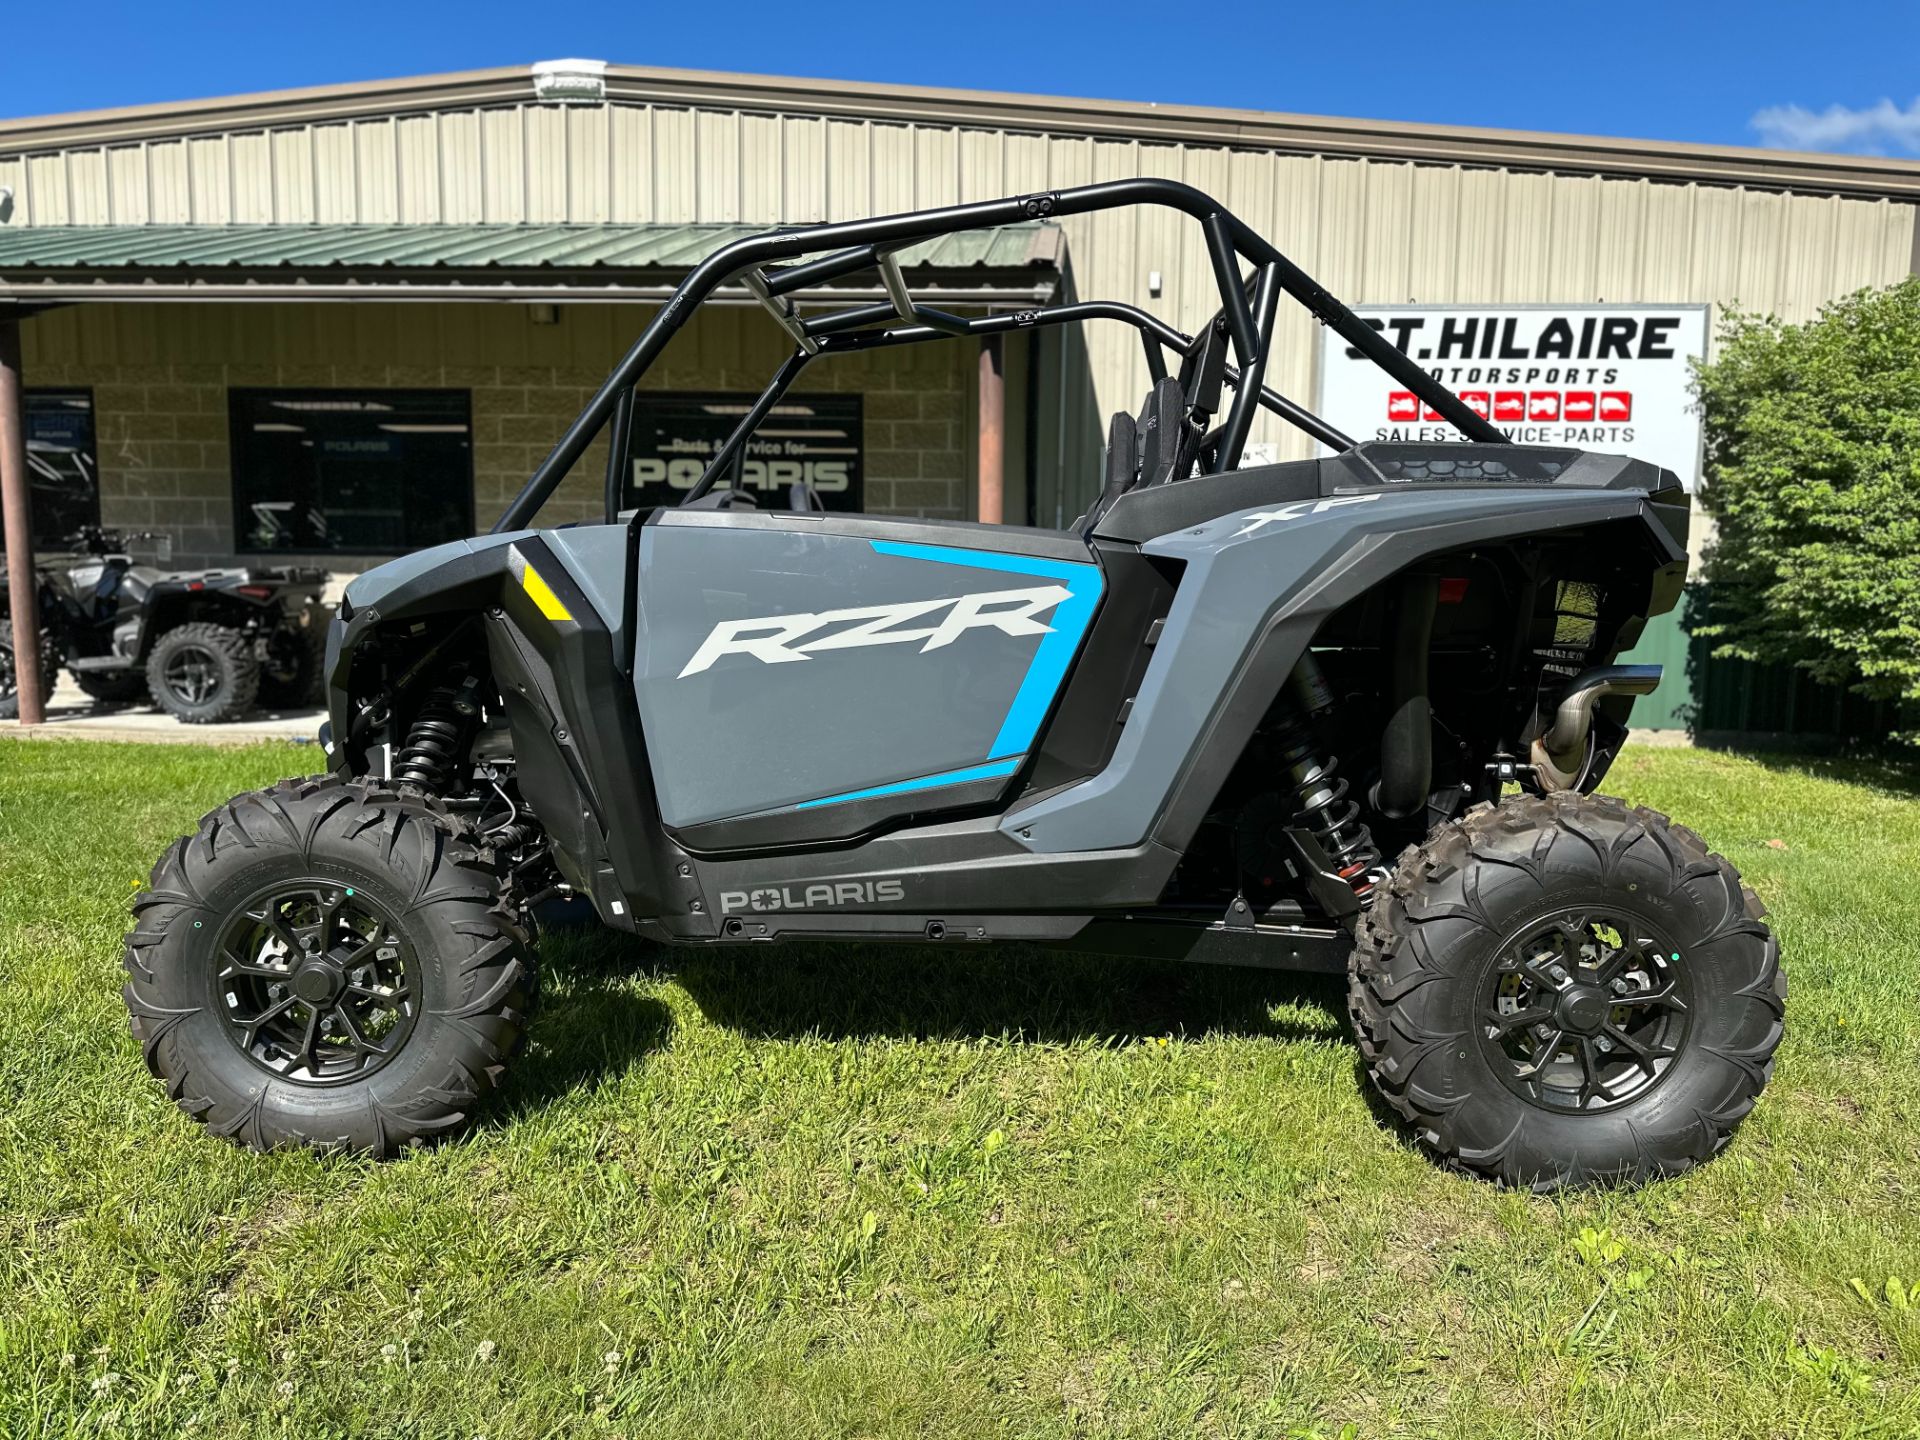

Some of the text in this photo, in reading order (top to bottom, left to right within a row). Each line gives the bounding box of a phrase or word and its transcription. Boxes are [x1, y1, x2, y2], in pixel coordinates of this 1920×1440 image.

[1419, 367, 1619, 385] OTORSPORTS
[746, 439, 782, 455] rvice
[1375, 427, 1635, 443] SALES-VICE-PARTS
[1229, 493, 1383, 538] XP
[676, 585, 1076, 680] RZR
[720, 880, 905, 914] POLARIS
